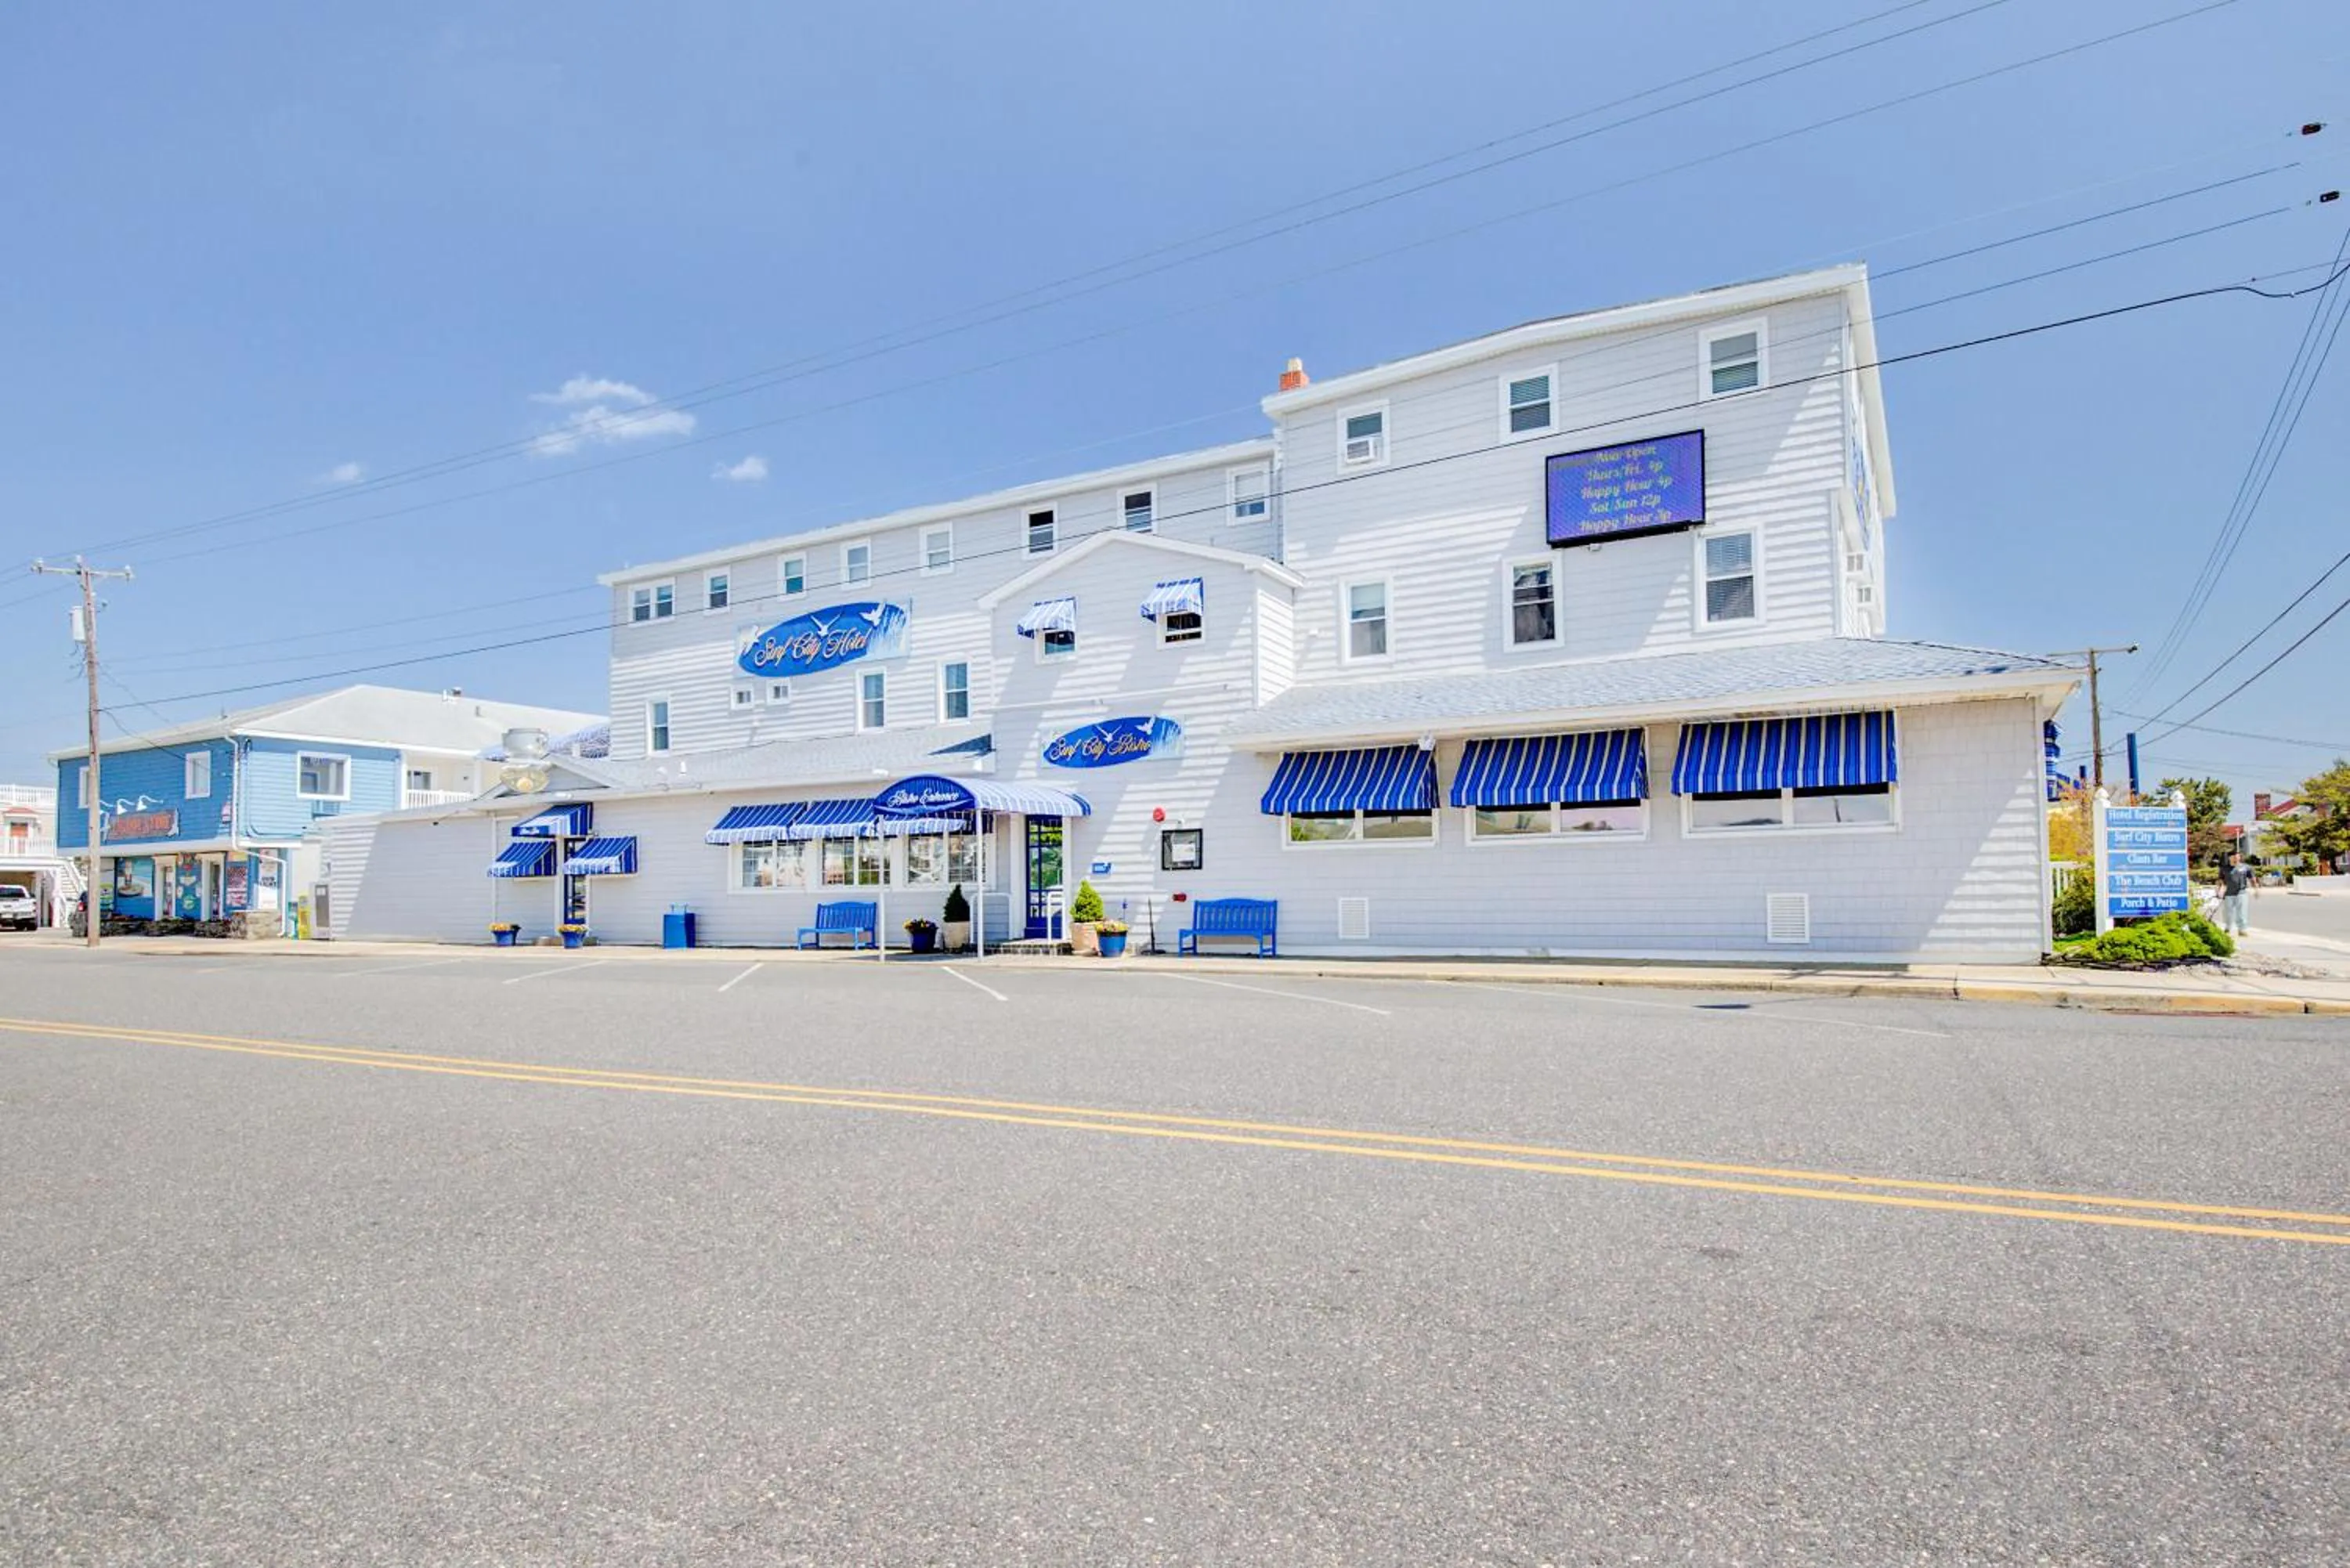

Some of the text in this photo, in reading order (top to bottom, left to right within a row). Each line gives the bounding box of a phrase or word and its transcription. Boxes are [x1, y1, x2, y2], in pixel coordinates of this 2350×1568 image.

[754, 627, 873, 666] Surf City Hotel
[1049, 732, 1152, 761] Surf City Bistro
[2115, 831, 2132, 842] Surf
[2135, 831, 2153, 844] City
[2116, 875, 2132, 886] The
[2120, 896, 2178, 908] Porch & Patio
